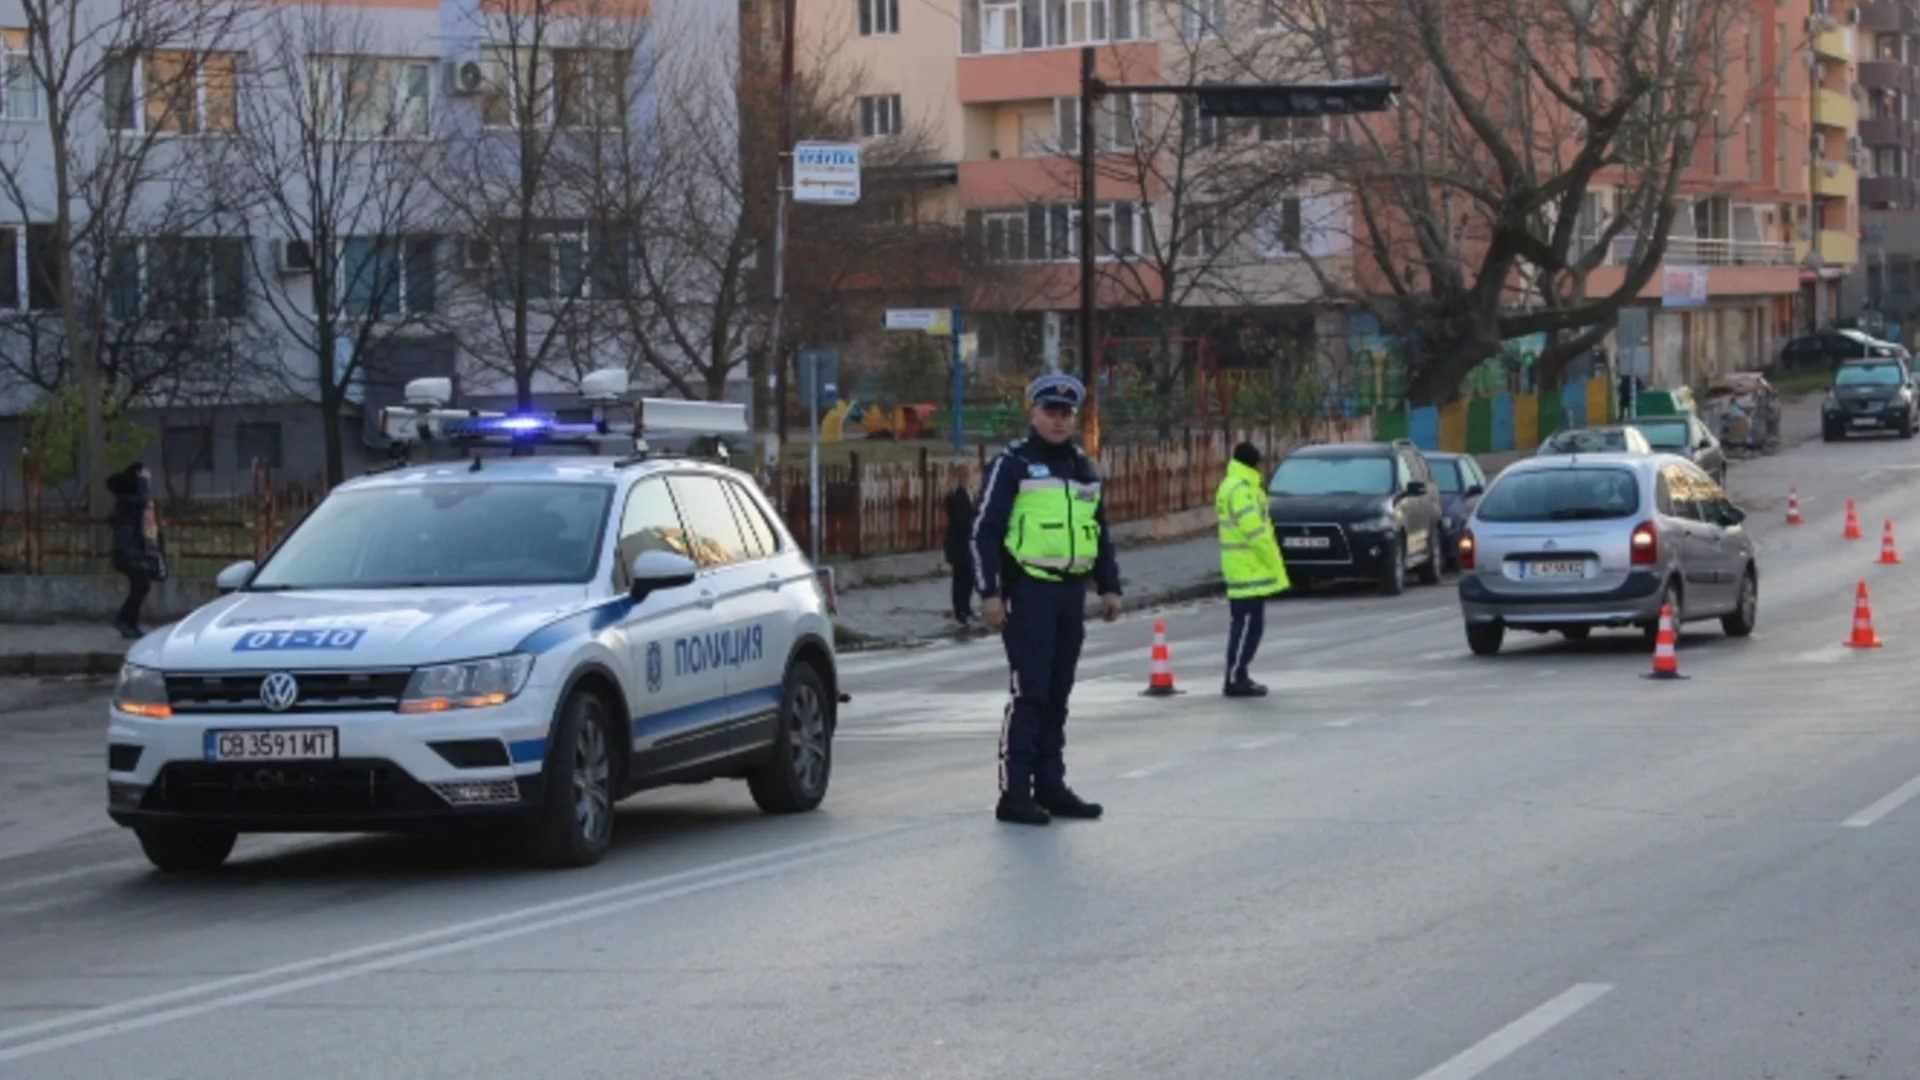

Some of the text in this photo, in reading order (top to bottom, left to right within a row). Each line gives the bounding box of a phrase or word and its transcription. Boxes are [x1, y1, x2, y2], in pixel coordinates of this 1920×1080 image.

[248, 629, 358, 648] 01-10
[675, 624, 762, 676] ПОЛИЦИЯ
[248, 732, 297, 756] 3591
